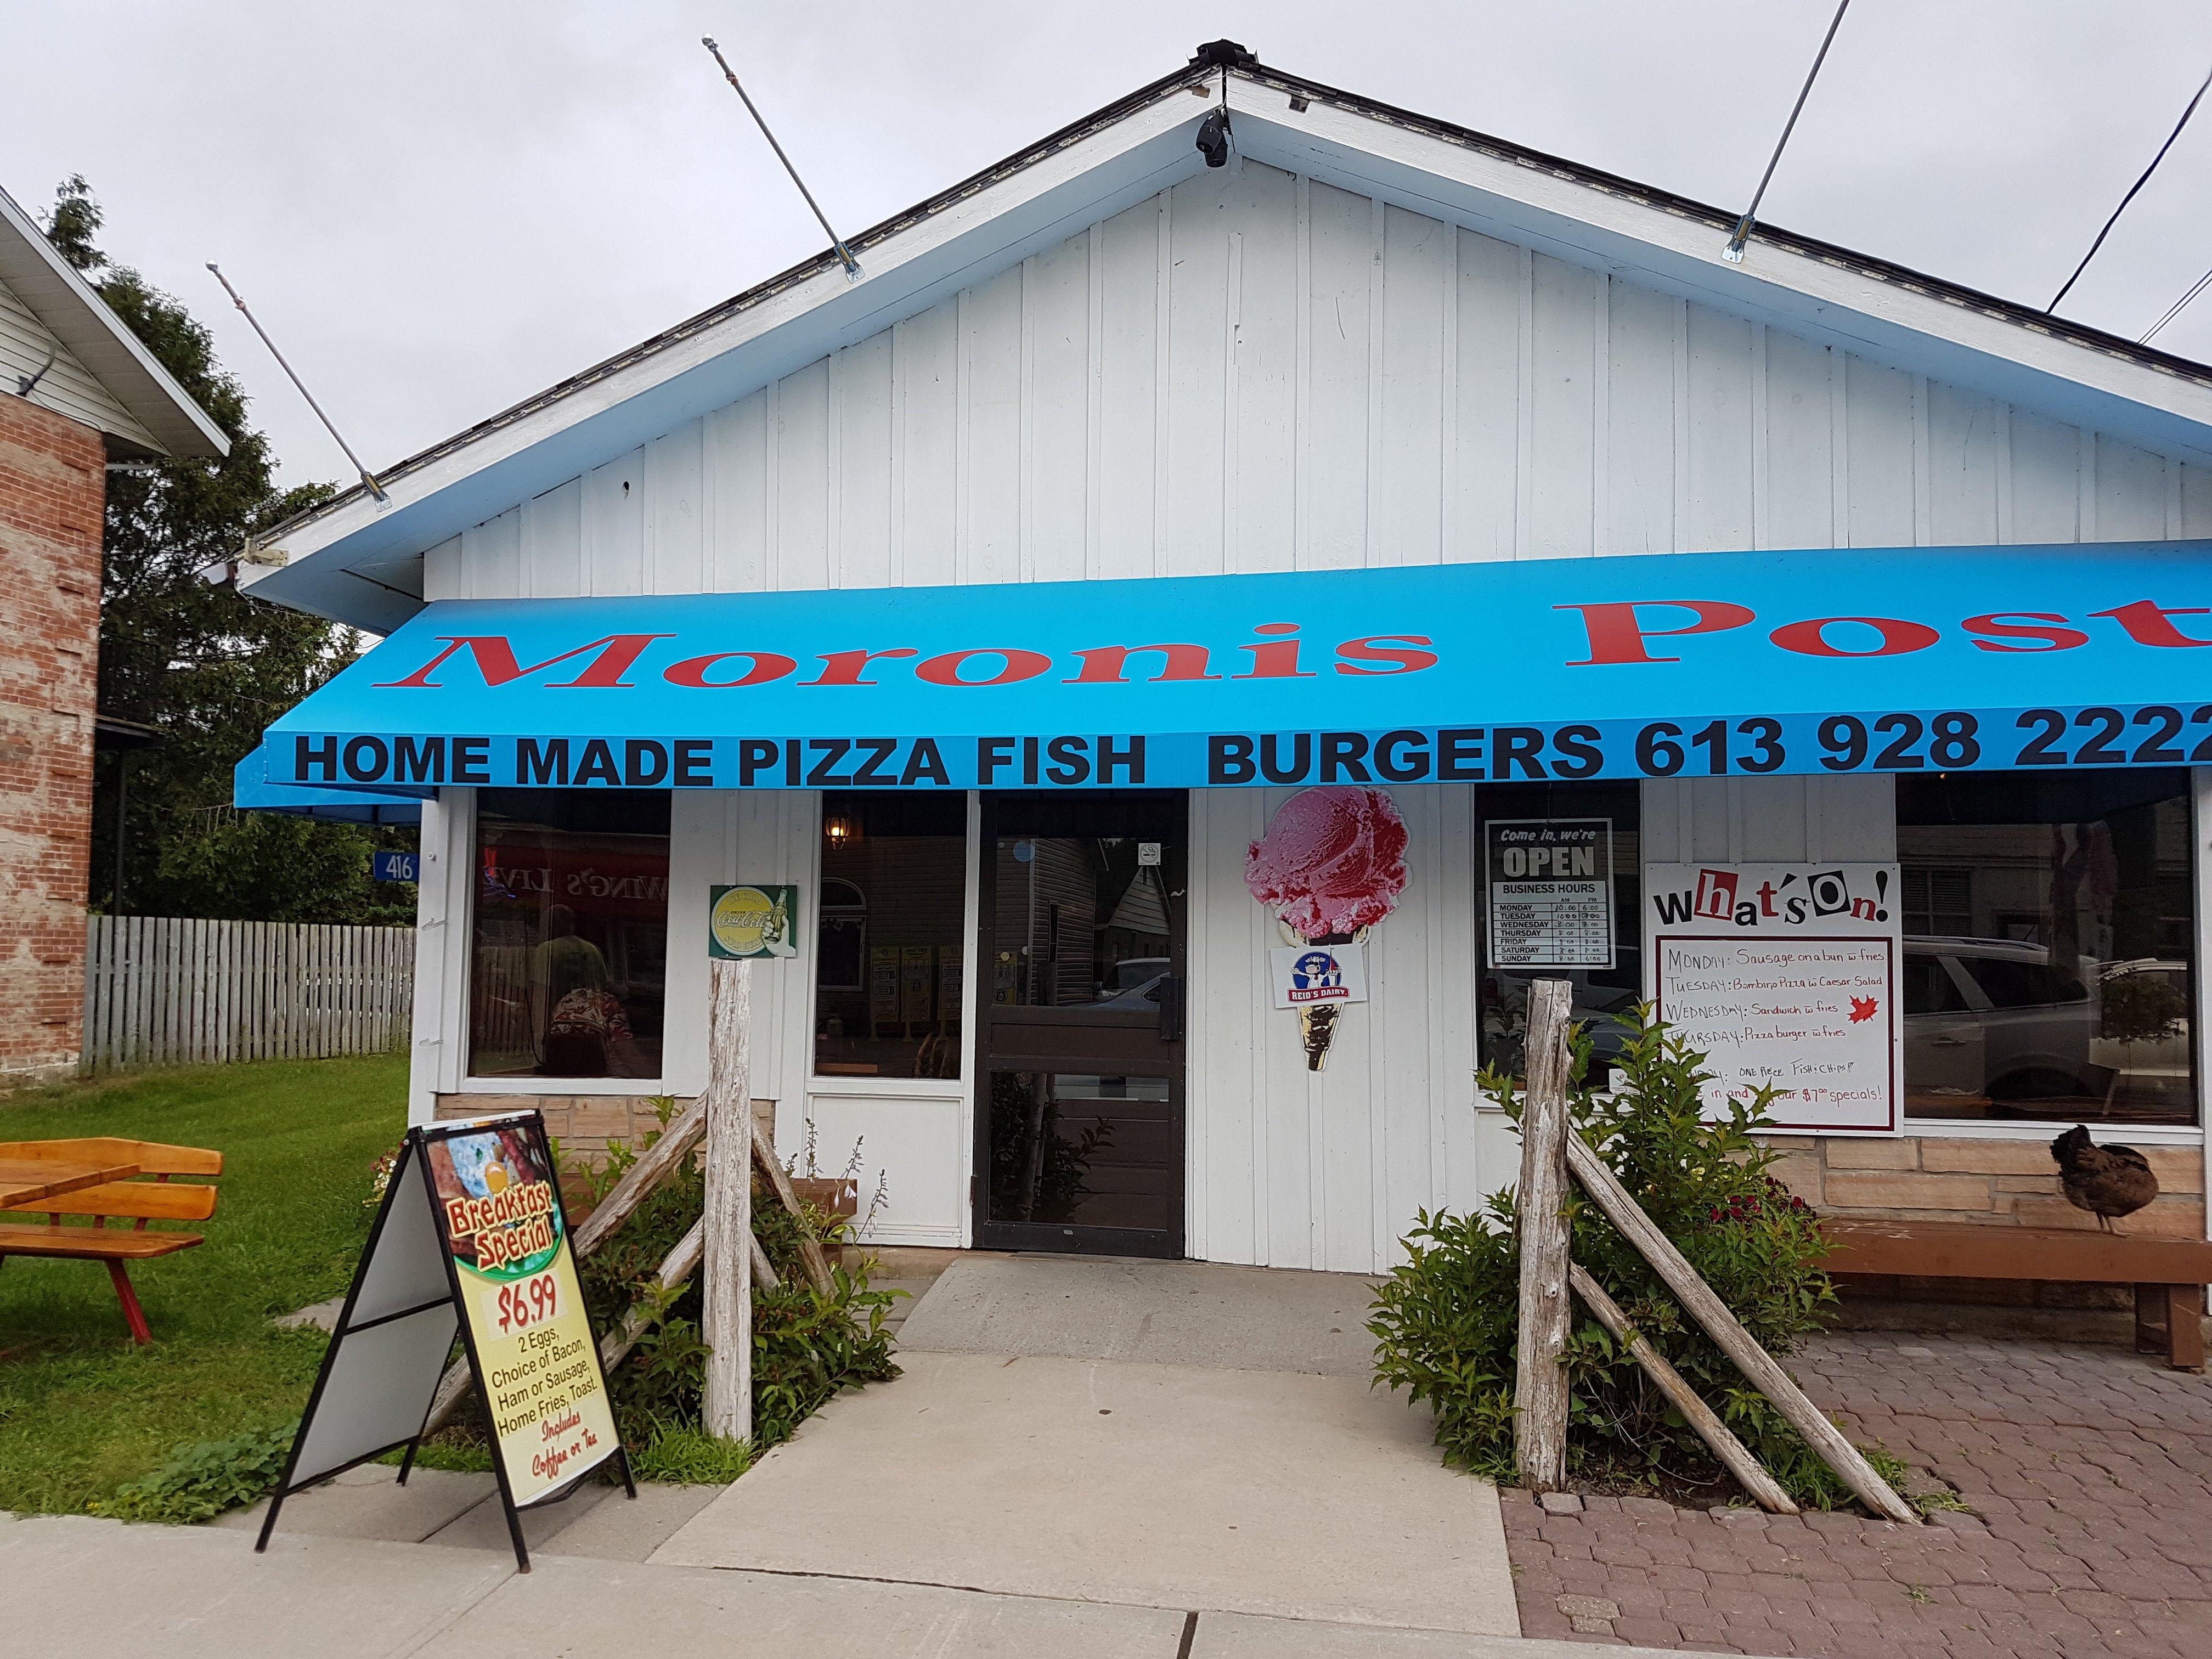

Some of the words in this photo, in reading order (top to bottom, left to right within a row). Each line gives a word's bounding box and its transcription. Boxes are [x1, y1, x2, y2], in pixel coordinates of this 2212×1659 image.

[371, 623, 1438, 687] Moronis
[1552, 599, 2212, 667] Post
[294, 735, 490, 784] HOME
[516, 738, 714, 787] MADE
[739, 737, 950, 786] PIZZA
[977, 735, 1146, 785] FISH
[1207, 724, 1604, 785] BURGERS
[1635, 717, 1786, 777] 613
[1818, 712, 1981, 770] 928
[1500, 829, 1536, 841] Come
[1540, 828, 1556, 842] in,
[1560, 828, 1596, 840] we're
[385, 855, 413, 879] 416
[1503, 847, 1594, 877] OPEN
[1503, 884, 1555, 893] BUSINESS
[1558, 884, 1595, 893] HOURS
[1652, 868, 1808, 926] What's
[1808, 870, 1888, 922] On!
[1668, 949, 1731, 973] MONDAY:
[1736, 949, 1795, 967] Sausage
[1821, 949, 1843, 962] bun
[1858, 948, 1884, 961] fries
[1291, 990, 1318, 1000] REID'S
[1666, 977, 1731, 995] TUESDAY:
[1733, 978, 1778, 990] Bambino
[1778, 976, 1805, 988] Pizza
[1819, 976, 1851, 986] Caesar
[1854, 975, 1883, 987] Salad
[1666, 1000, 1747, 1022] WEDNESDAY:
[1751, 1003, 1801, 1015] Sandwich
[1816, 1000, 1838, 1013] fries
[1745, 1026, 1774, 1041] Pizza
[1775, 1025, 1807, 1042] burger
[1822, 1025, 1846, 1037] fries
[1711, 1087, 1722, 1098] in
[1728, 1087, 1749, 1099] and
[1830, 1085, 1882, 1108] specials!
[475, 1214, 554, 1272] Special
[498, 1274, 556, 1334] $6.99
[518, 1336, 527, 1353] 2
[528, 1328, 560, 1350] Eggs,
[492, 1362, 537, 1389] Choice
[539, 1350, 550, 1368] of
[552, 1339, 586, 1362] Bacon,
[498, 1387, 529, 1412] Ham
[531, 1380, 543, 1396] or
[545, 1359, 591, 1389] Sausage,
[498, 1409, 537, 1437] Home
[538, 1396, 569, 1418] Fries,
[569, 1375, 598, 1401] Toast.
[541, 1407, 581, 1442] Includes
[532, 1446, 568, 1480] Coffee
[571, 1442, 582, 1457] or
[582, 1427, 597, 1449] Tea
